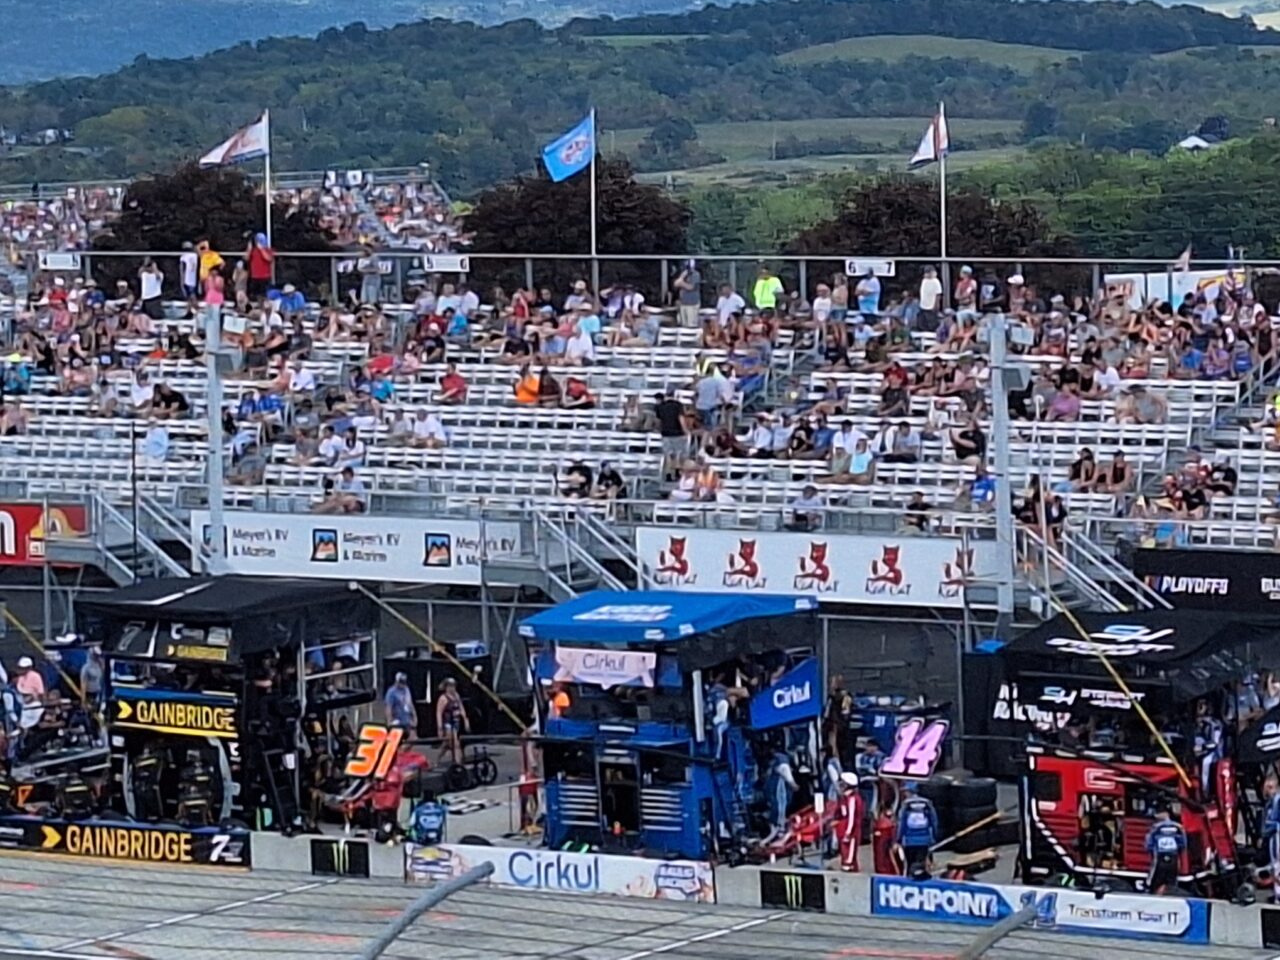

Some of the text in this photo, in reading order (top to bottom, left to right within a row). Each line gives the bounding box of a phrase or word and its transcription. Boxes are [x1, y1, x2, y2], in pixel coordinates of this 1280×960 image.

[848, 261, 893, 274] 6 7
[582, 653, 626, 672] Cirkul
[772, 680, 811, 710] Cirkul
[136, 700, 236, 731] GAINBRIDGE
[343, 724, 404, 779] 31
[880, 718, 949, 780] 14
[66, 825, 193, 863] GAINBRIDGE
[508, 851, 600, 890] Cirkul
[1068, 903, 1132, 922] Transform
